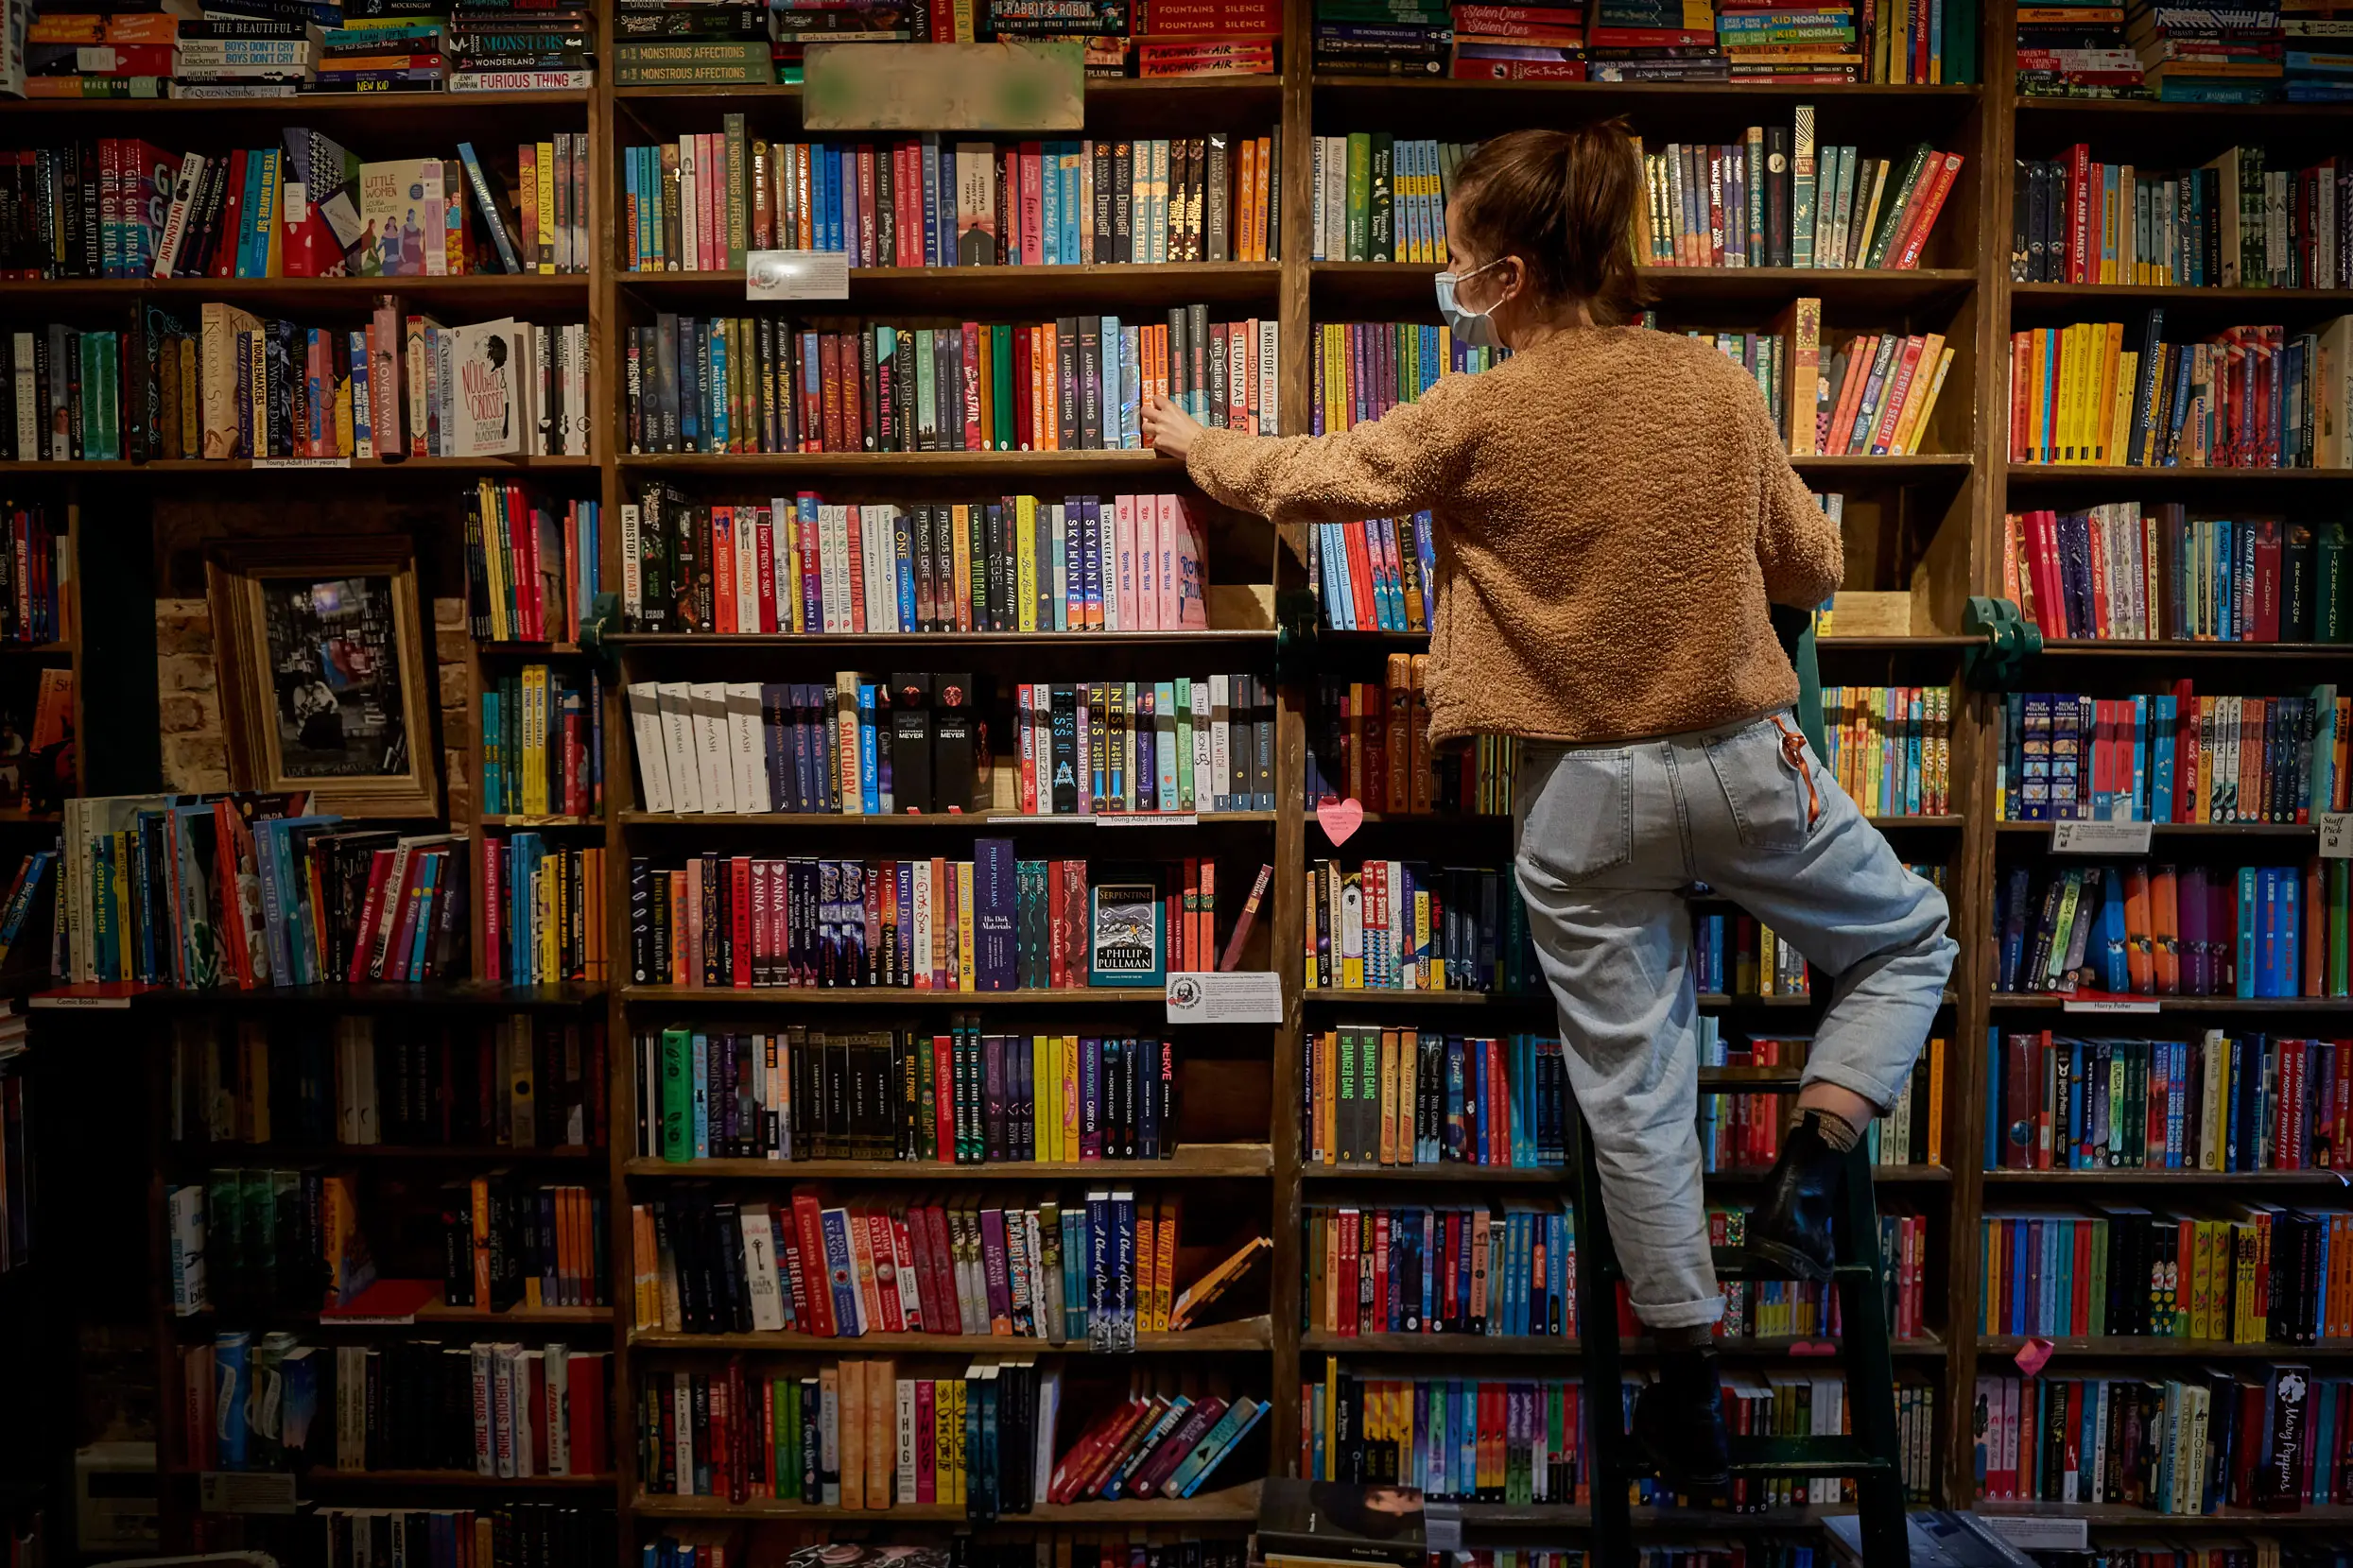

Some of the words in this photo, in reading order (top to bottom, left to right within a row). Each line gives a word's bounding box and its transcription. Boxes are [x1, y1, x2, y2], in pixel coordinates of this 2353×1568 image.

[213, 24, 233, 33] THE
[236, 23, 291, 32] BEAUTIFUL
[1792, 15, 1838, 24] NORMAL
[1798, 28, 1844, 37] NORMAL
[225, 42, 248, 51] BOYS
[250, 42, 275, 51] DON'T
[278, 42, 295, 51] CRY
[226, 54, 248, 63] BOYS
[250, 54, 275, 62] DON'T
[277, 54, 293, 62] CRY
[640, 47, 691, 59] MONSTROUS
[694, 46, 745, 58] AFFECTIONS
[476, 58, 535, 66] WONDERLAND
[640, 68, 691, 79] MONSTROUS
[694, 67, 745, 78] AFFECTIONS
[481, 76, 529, 87] FURIOUS
[533, 74, 568, 87] THING
[264, 154, 275, 170] YES
[730, 142, 740, 194] MONSTROUS
[102, 168, 114, 194] GIRL
[125, 170, 137, 195] GIRL
[263, 172, 272, 184] NO
[84, 182, 95, 204] THE
[259, 187, 271, 218] MAYBE
[103, 198, 114, 226] GONE
[125, 198, 137, 227] GONE
[731, 198, 741, 249] AFFECTIONS
[1136, 217, 1145, 231] LIE
[1154, 217, 1163, 231] LIE
[85, 208, 96, 264] BEAUTIFUL
[161, 203, 183, 262] INTERNMENT
[257, 220, 268, 232] SO
[105, 231, 116, 262] VIRAL
[126, 231, 137, 263] VIRAL
[1136, 233, 1145, 258] TREE
[1154, 233, 1163, 257] TREE
[1265, 332, 1274, 376] KRISTOFF
[380, 362, 389, 404] LOVELY
[880, 366, 890, 395] BREAK
[1234, 336, 1243, 405] ILLUMINAE
[881, 397, 890, 414] THE
[381, 408, 389, 436] WAR
[882, 417, 891, 437] FALL
[626, 517, 635, 560] KRISTOFF
[919, 511, 930, 552] PITTACUS
[940, 511, 950, 552] PITTACUS
[895, 531, 907, 560] ONE
[921, 556, 930, 578] LORE
[942, 556, 950, 578] LORE
[1068, 520, 1079, 611] SKYHUNTER
[1085, 520, 1097, 610] SKYHUNTER
[840, 722, 856, 794] SANCTUARY
[1080, 748, 1088, 792] PARTNERS
[1099, 959, 1150, 968] PULLMAN
[1341, 1044, 1353, 1075] DANGER
[1363, 1045, 1375, 1076] DANGER
[1341, 1077, 1353, 1098] GANG
[1364, 1077, 1375, 1099] GANG
[1086, 1100, 1095, 1121] CARRY
[1086, 1122, 1094, 1131] ON
